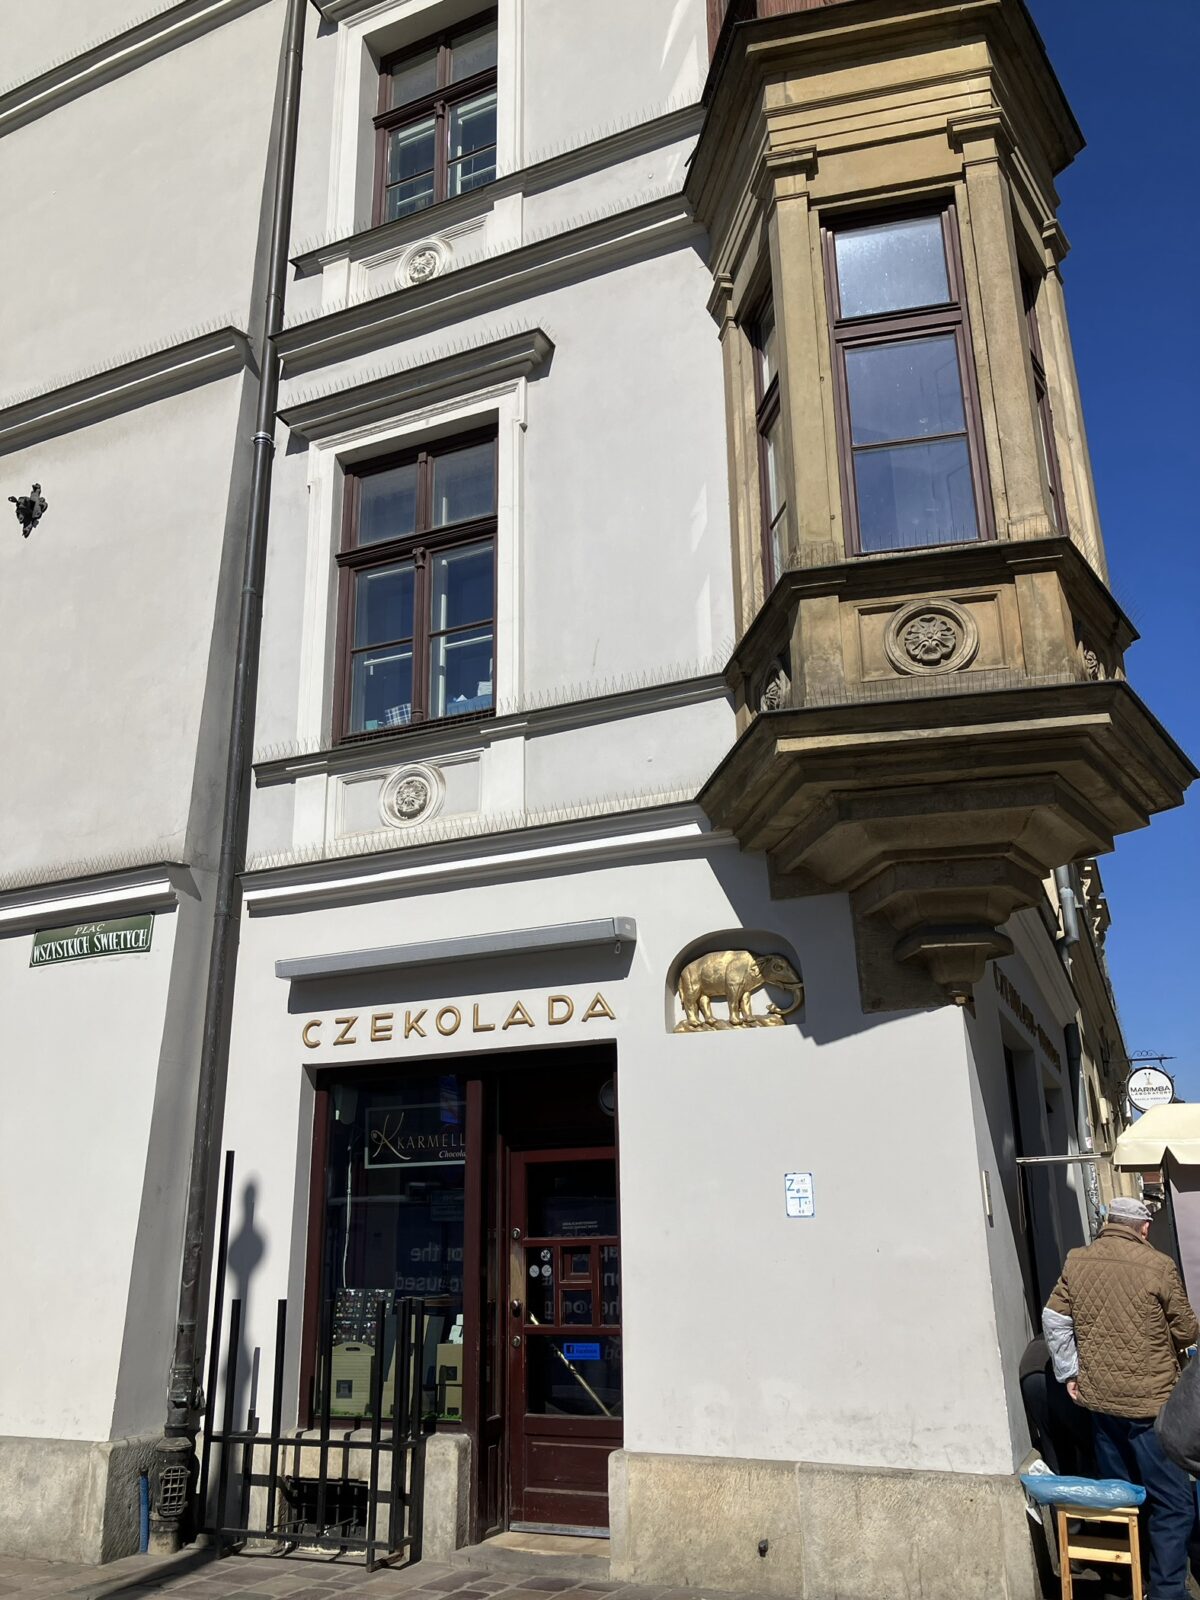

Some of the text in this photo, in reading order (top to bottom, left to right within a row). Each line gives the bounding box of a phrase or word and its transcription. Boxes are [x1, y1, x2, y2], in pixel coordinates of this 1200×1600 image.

[33, 928, 148, 962] WSZYSTKICH ŚWIĘTYCH
[74, 923, 105, 935] PLAC
[302, 992, 616, 1049] CZEKOLADA
